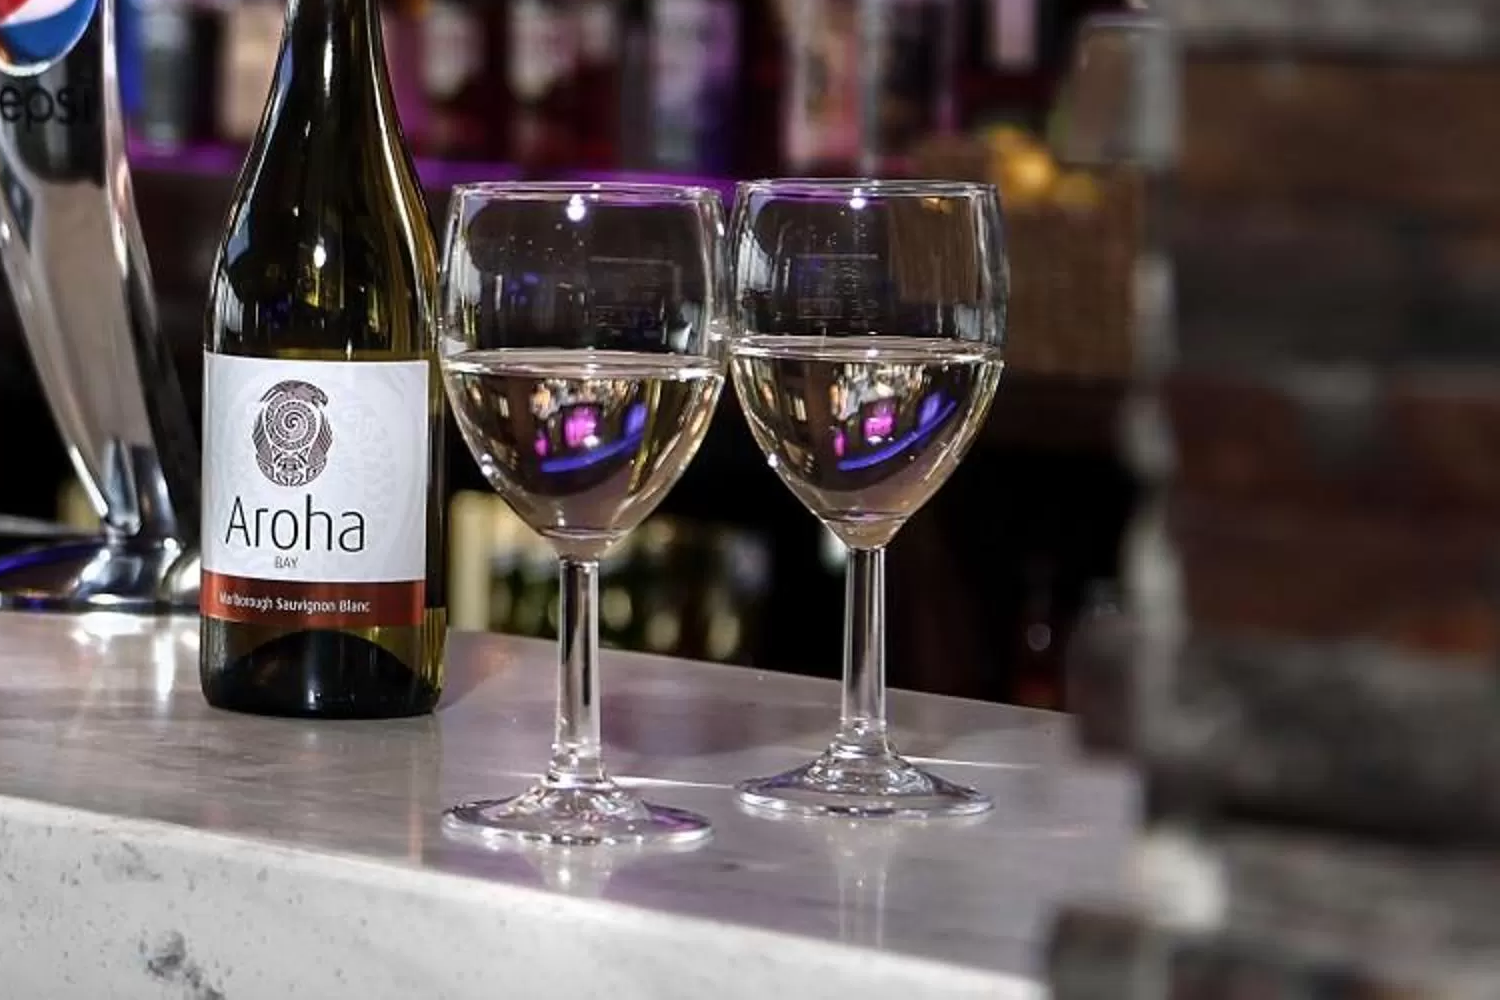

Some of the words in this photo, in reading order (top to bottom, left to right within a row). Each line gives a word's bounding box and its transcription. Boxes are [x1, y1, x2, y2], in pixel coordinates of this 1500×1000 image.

[225, 494, 366, 552] Aroha
[274, 556, 299, 569] BAY
[276, 597, 336, 615] Sauvignon
[339, 599, 371, 613] Blanc
